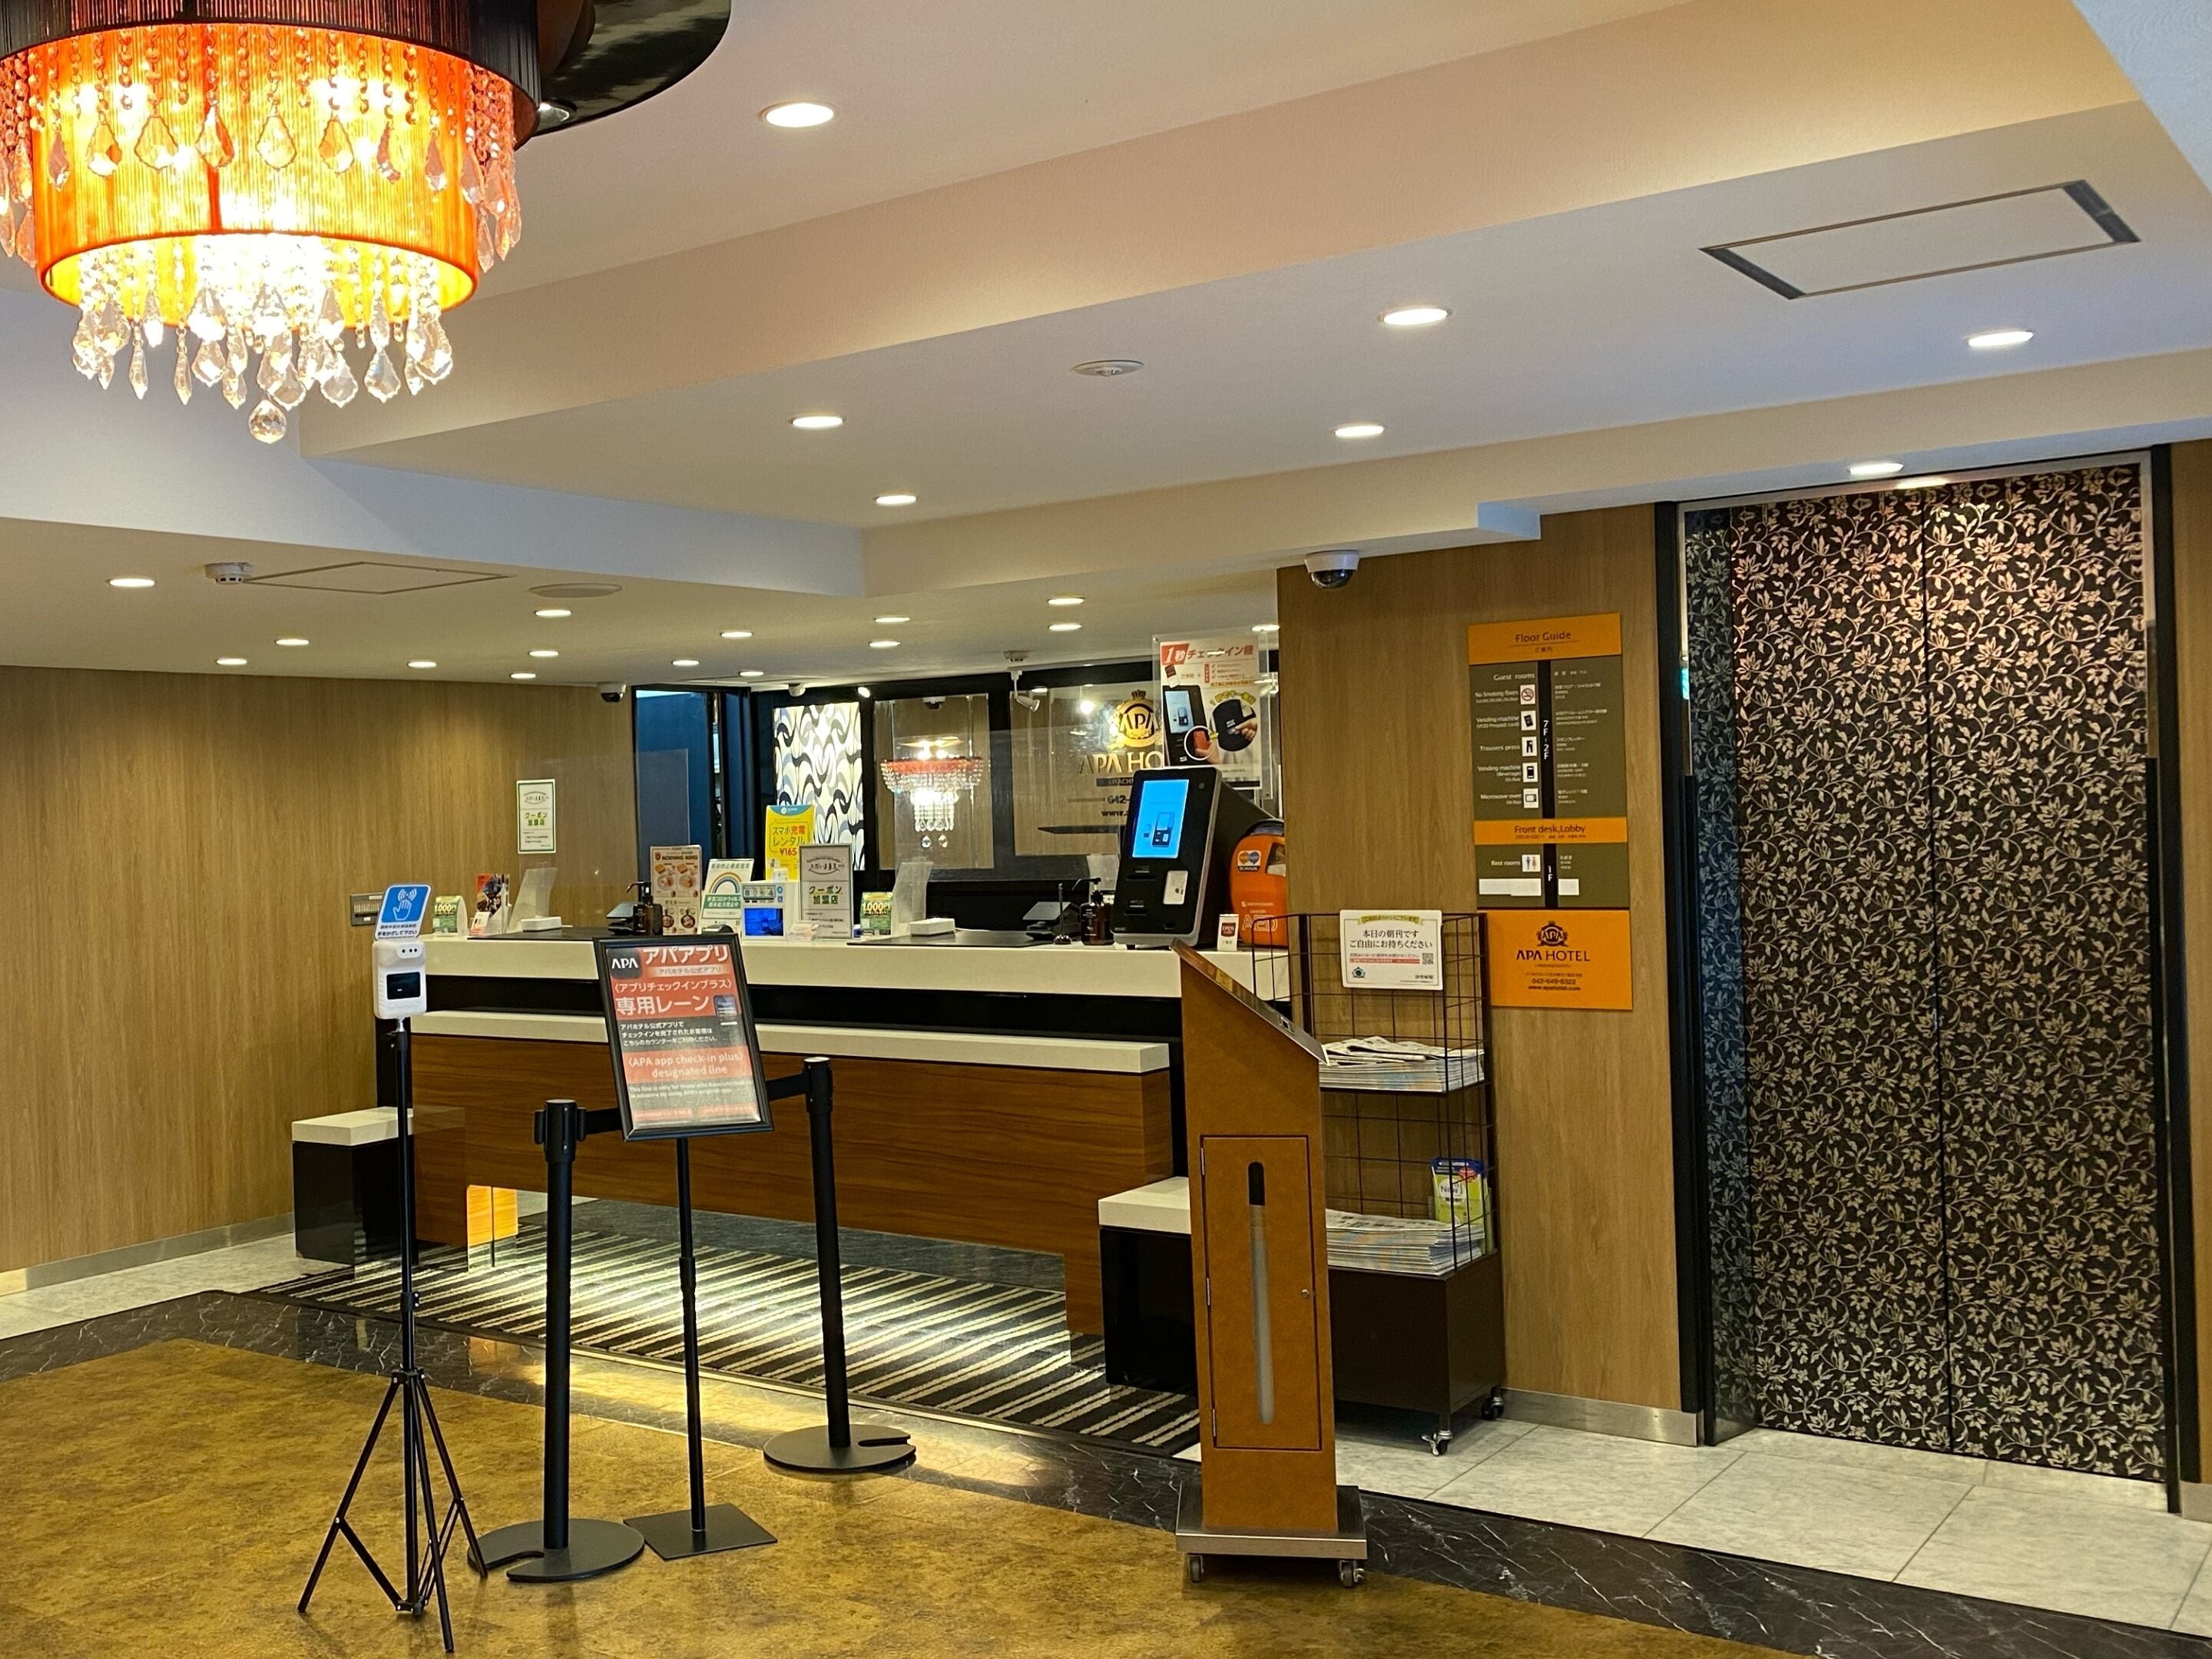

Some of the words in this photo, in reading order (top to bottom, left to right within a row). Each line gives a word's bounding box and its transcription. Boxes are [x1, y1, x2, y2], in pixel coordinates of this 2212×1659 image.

[1515, 633, 1540, 643] Floor
[1541, 631, 1571, 641] Guide
[1079, 753, 1124, 774] APA
[773, 826, 806, 836] スマホ充電
[773, 836, 806, 846] レンタル
[809, 885, 842, 895] クーポン
[813, 895, 839, 905] 加盟店
[1363, 929, 1419, 939] 本日の朝刊です
[1349, 939, 1433, 949] ご自由にお持ちください
[643, 945, 729, 965] アパアプリ
[1516, 950, 1542, 960] APA
[1545, 950, 1591, 962] HOTEL
[611, 957, 639, 969] APA
[658, 966, 721, 975] アパホテル公式アプリ
[615, 995, 709, 1016] 専用レーン
[620, 1021, 684, 1030] アパホテル公式アプリで
[654, 1057, 673, 1067] app
[676, 1054, 717, 1064] check-in
[651, 1066, 706, 1078] designated
[709, 1065, 728, 1075] line
